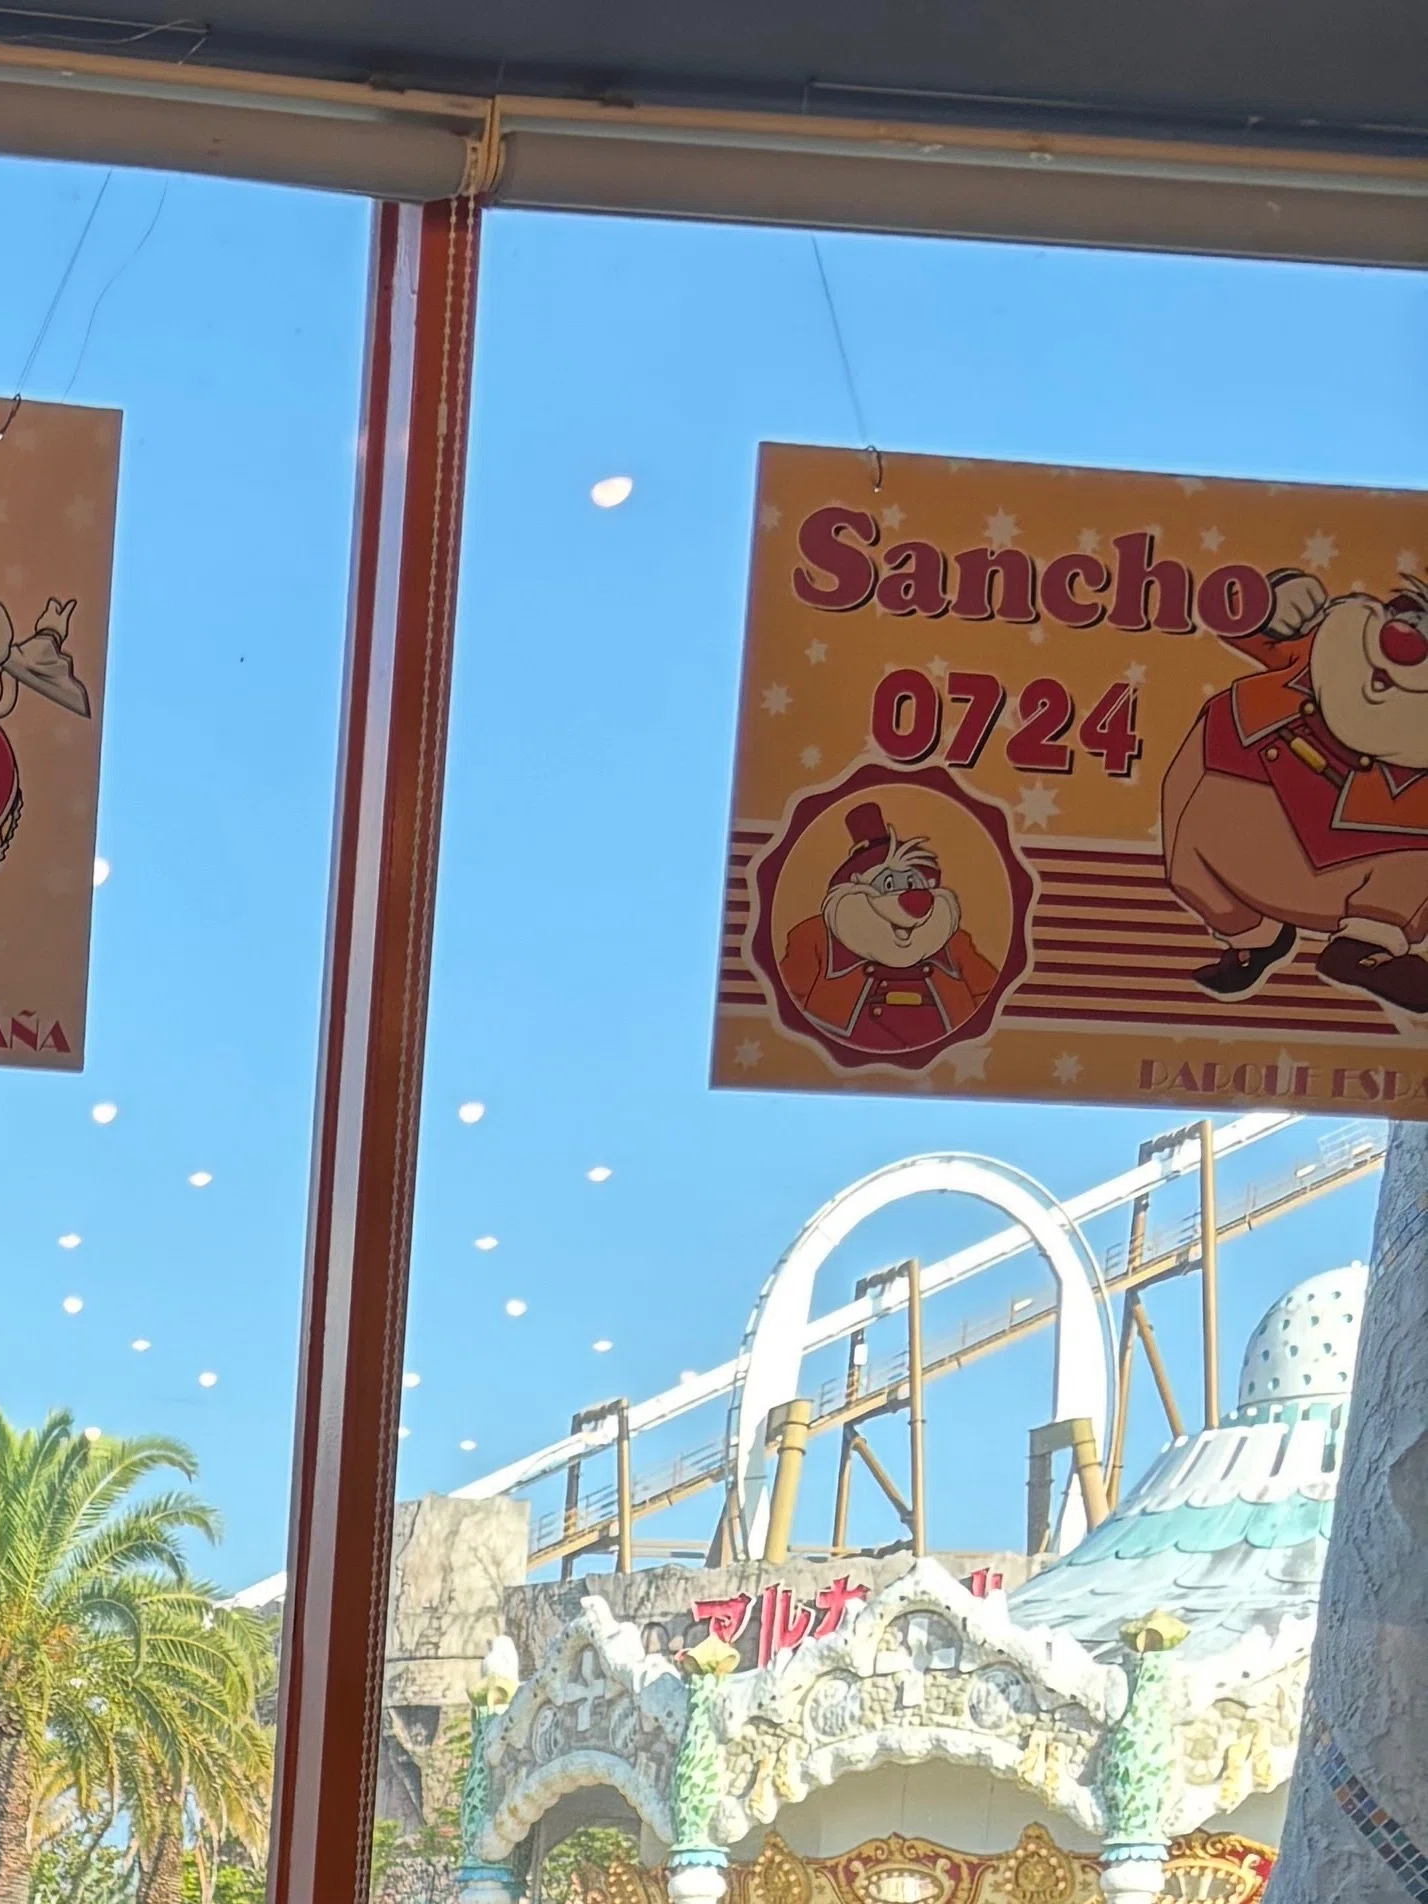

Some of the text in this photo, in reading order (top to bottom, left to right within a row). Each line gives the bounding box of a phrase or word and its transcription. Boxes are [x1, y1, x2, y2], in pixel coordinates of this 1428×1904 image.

[792, 506, 1277, 638] Sancho
[871, 667, 1142, 776] 0724
[1138, 1058, 1322, 1098] PARQUE
